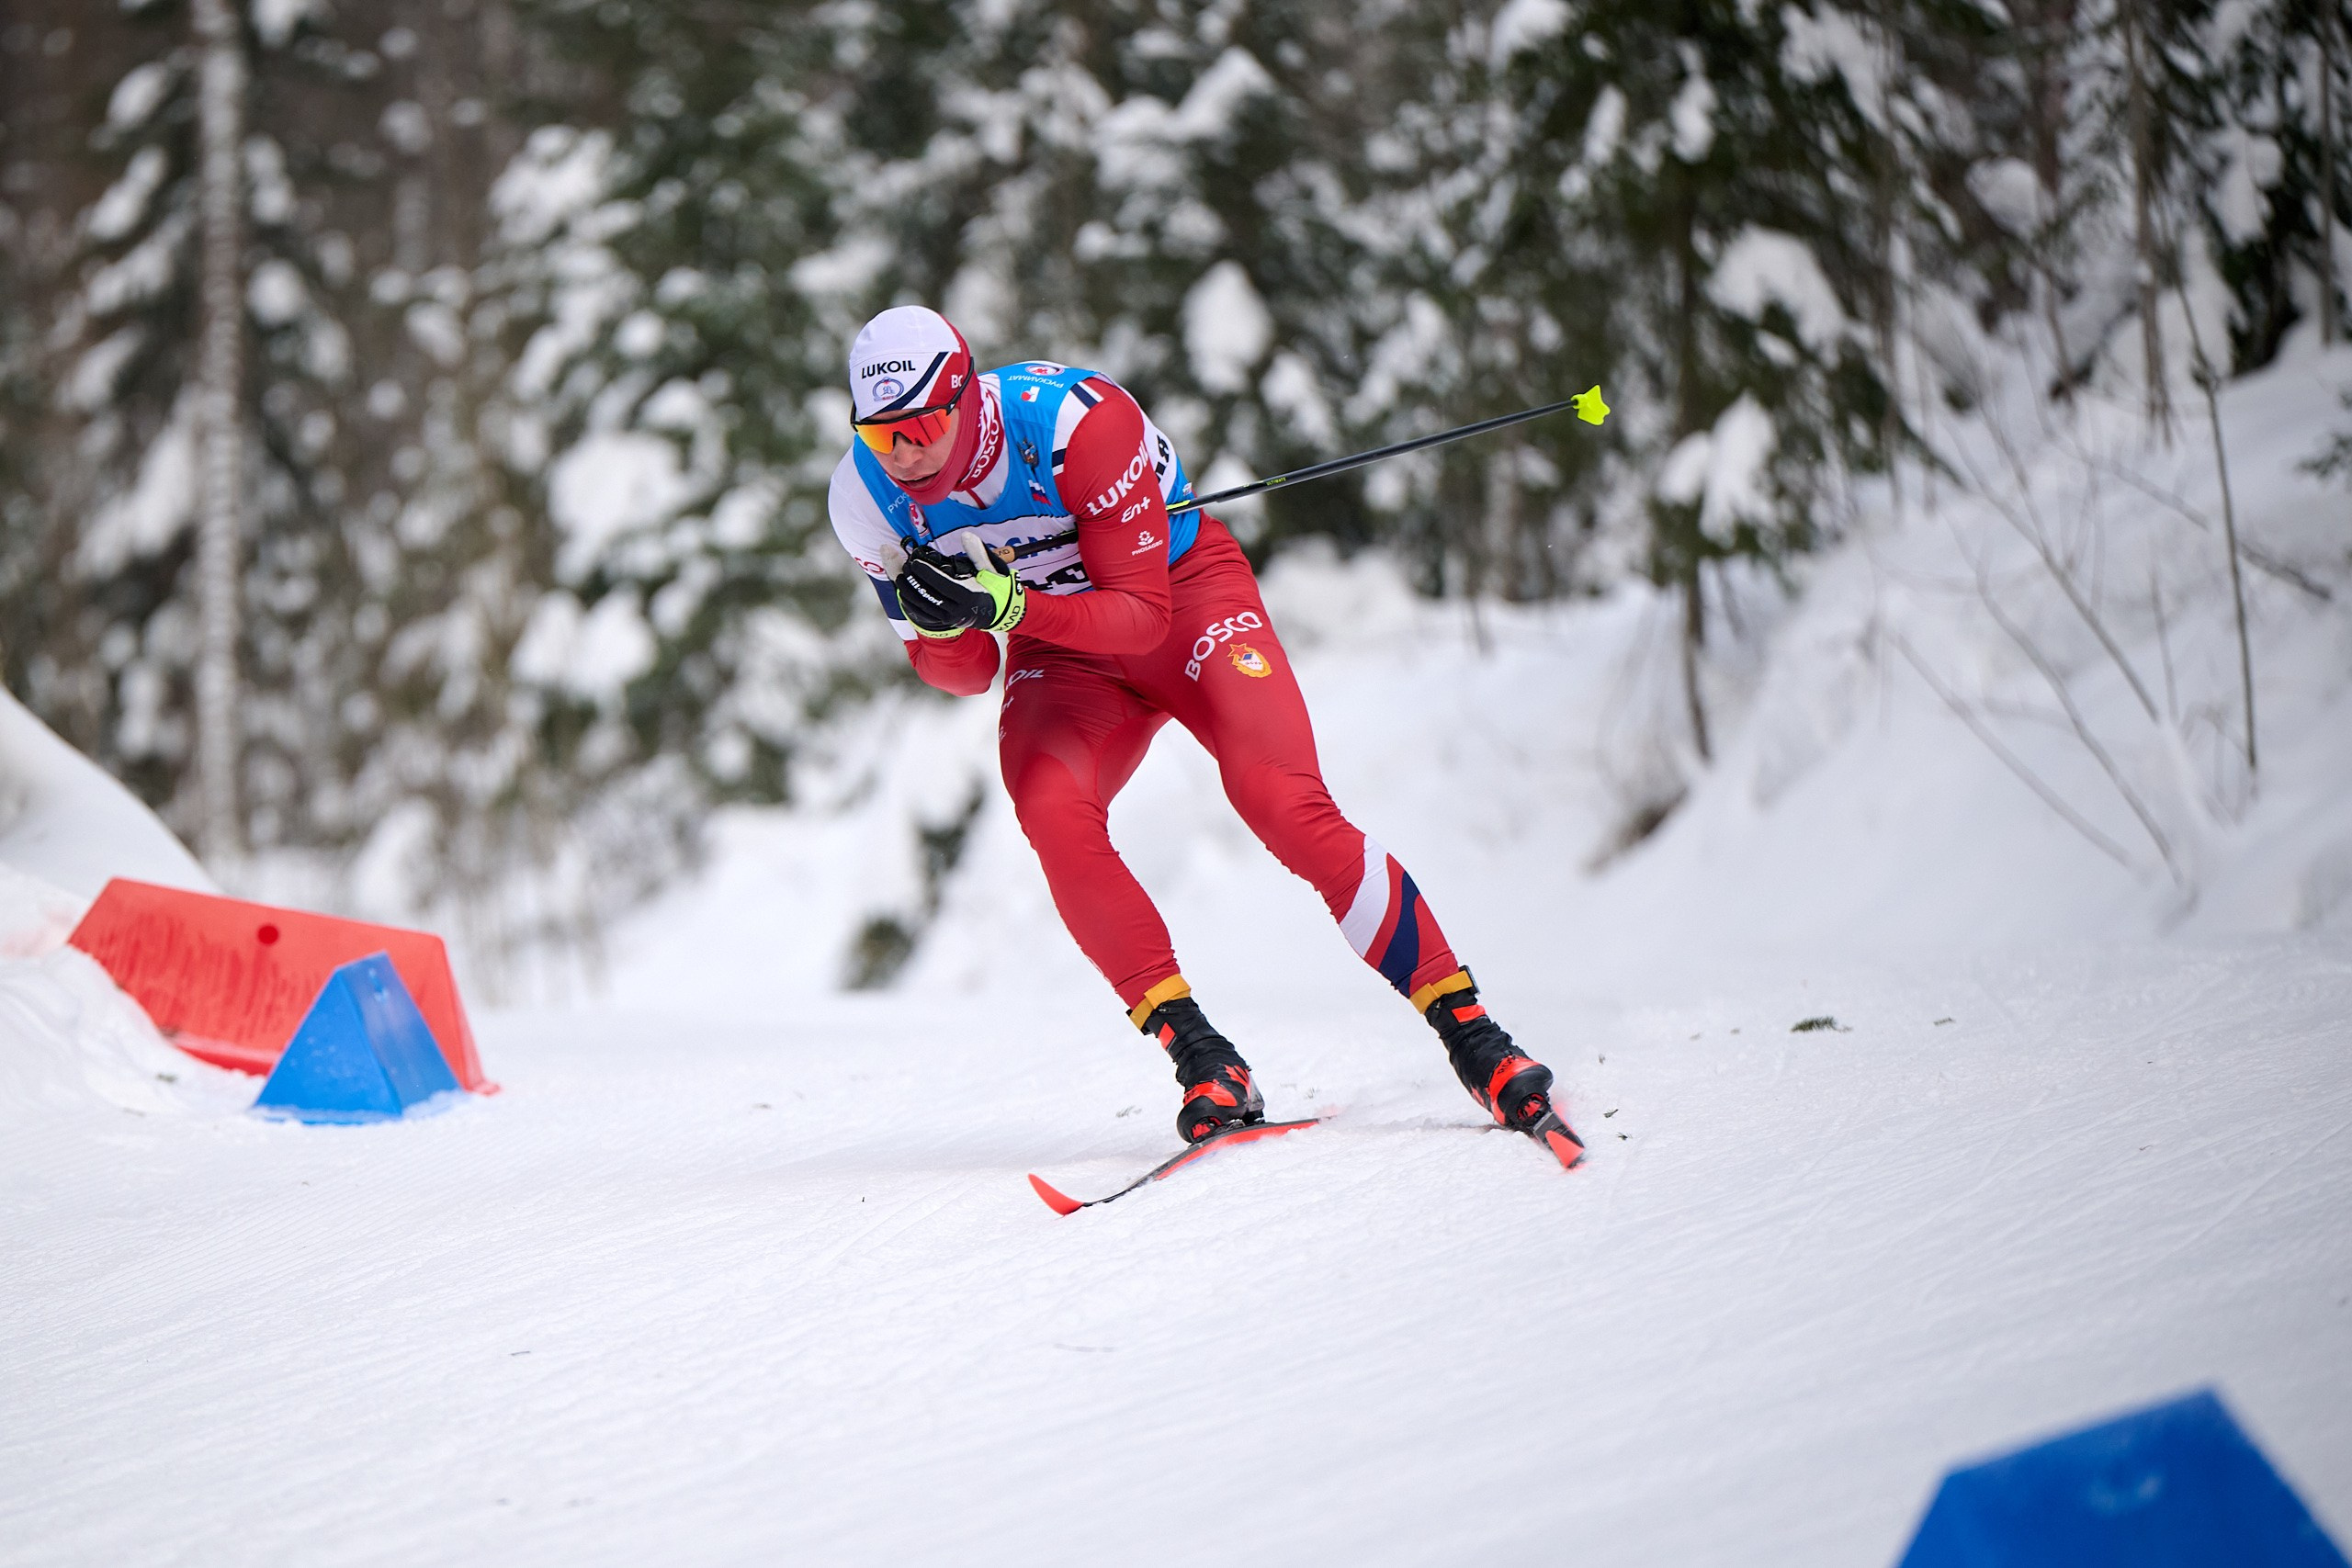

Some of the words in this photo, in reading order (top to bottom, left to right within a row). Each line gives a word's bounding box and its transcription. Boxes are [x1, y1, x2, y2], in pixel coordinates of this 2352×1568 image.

[862, 360, 916, 379] LUKOIL
[971, 419, 1000, 479] BOSCO
[1086, 439, 1148, 516] LUKOIL
[1131, 539, 1163, 557] PHOSAGRO
[1184, 611, 1263, 682] BOSCO
